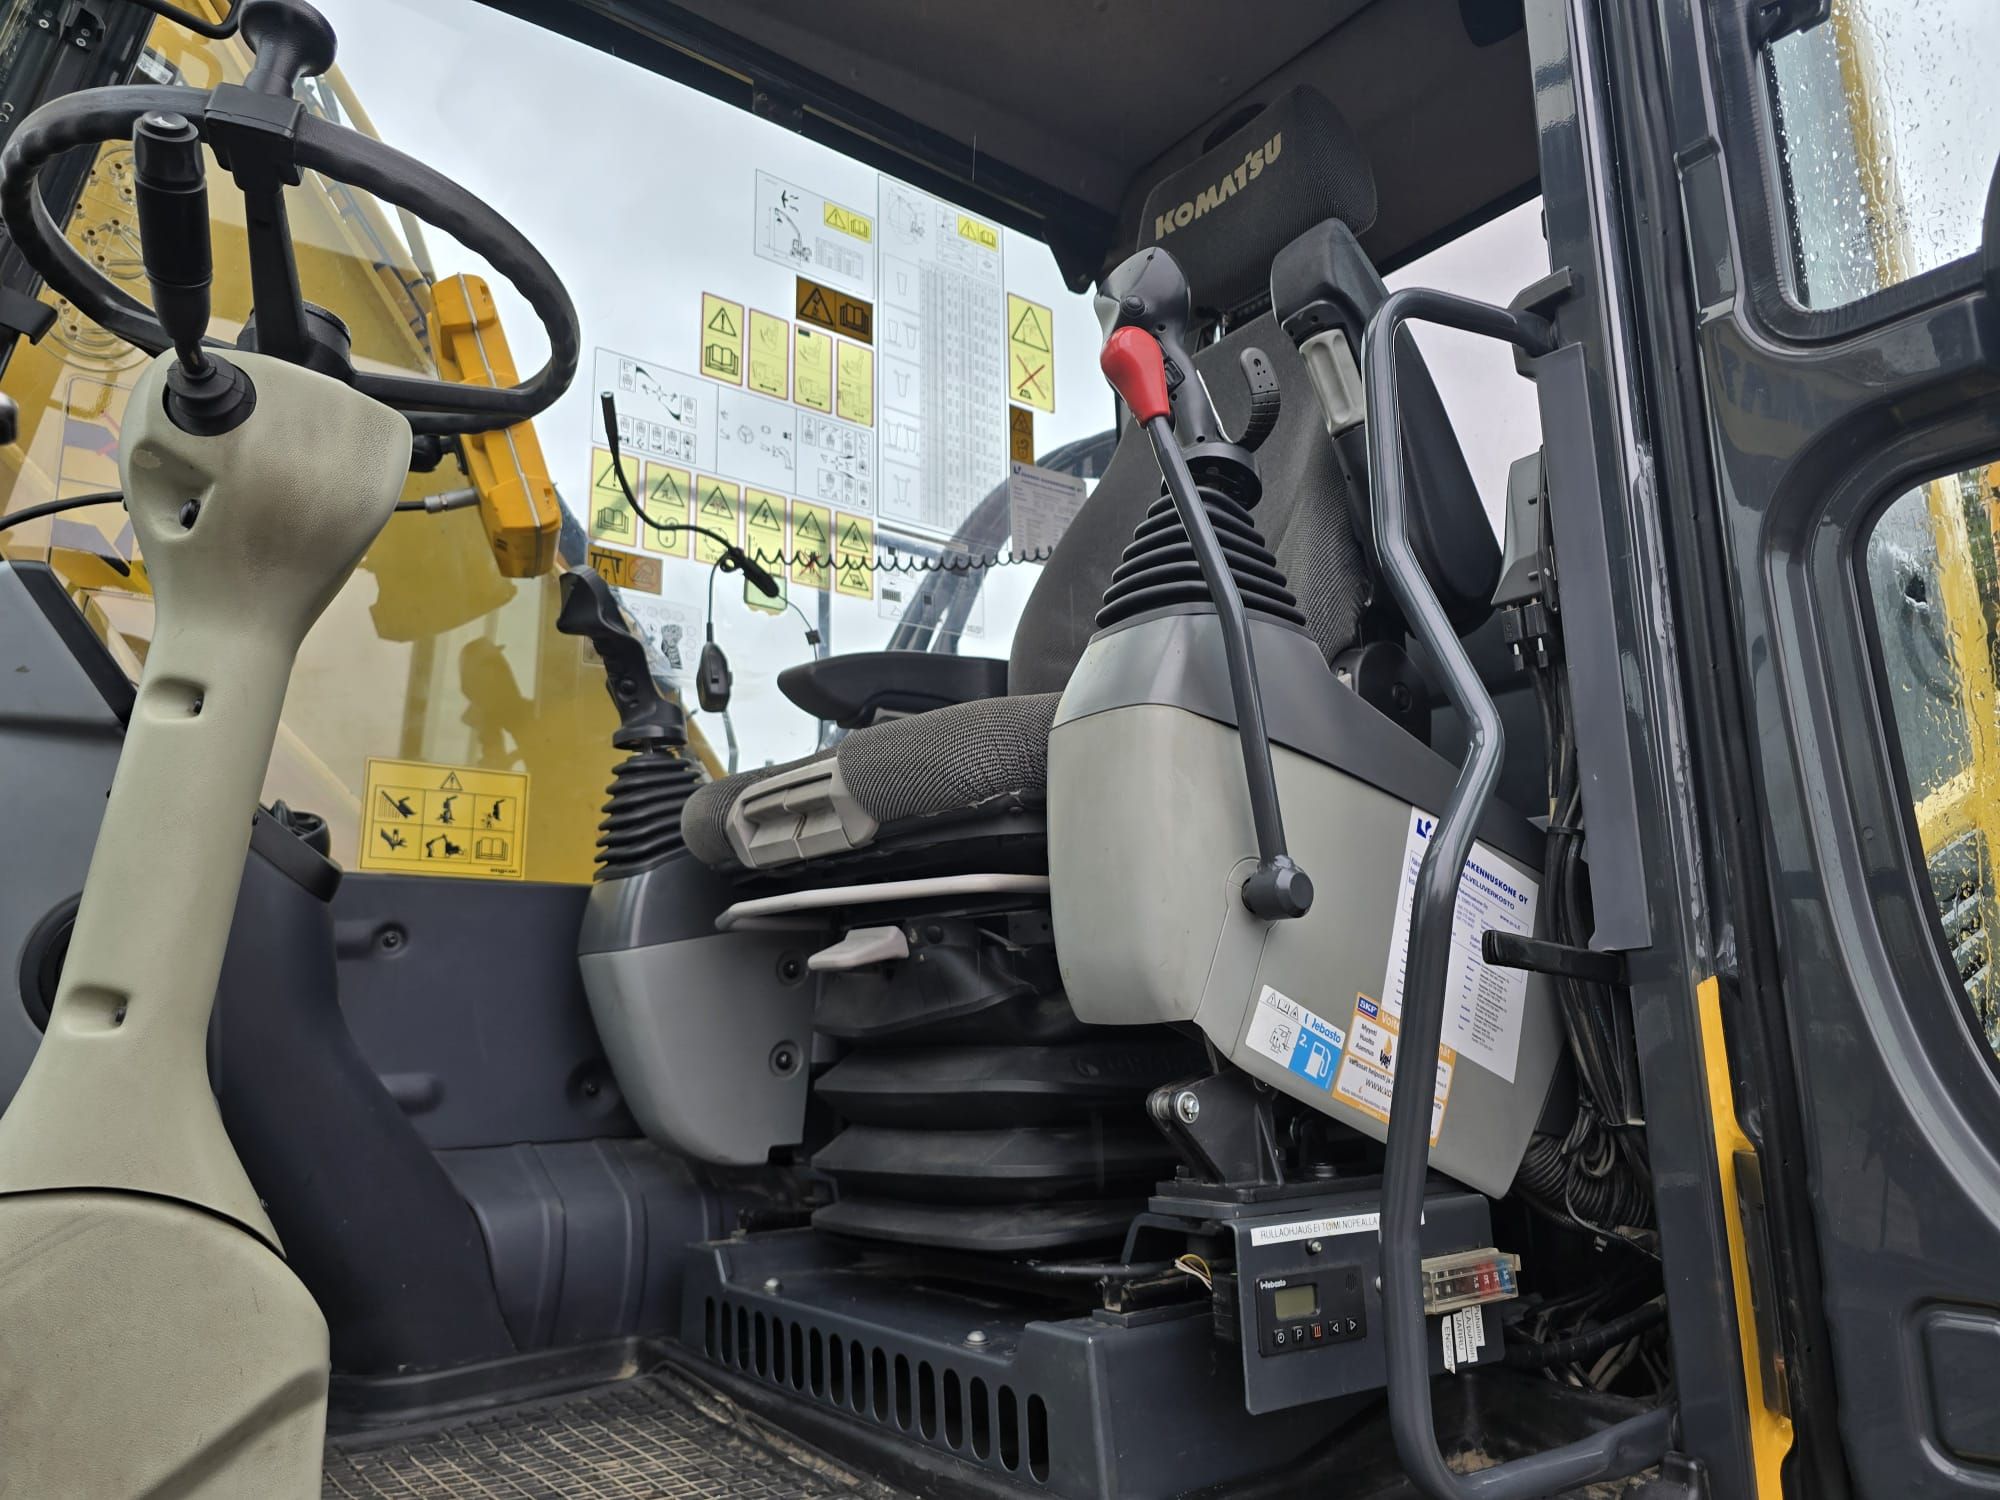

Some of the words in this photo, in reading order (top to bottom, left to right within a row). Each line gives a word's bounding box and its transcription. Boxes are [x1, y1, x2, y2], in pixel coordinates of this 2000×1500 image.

[1155, 131, 1283, 241] KOMATSU
[1462, 872, 1515, 911] ALVELUVERKOSTO
[1465, 859, 1517, 899] AKENNUSKONE
[1518, 893, 1529, 906] OY
[1342, 1216, 1378, 1229] NOPEALLA
